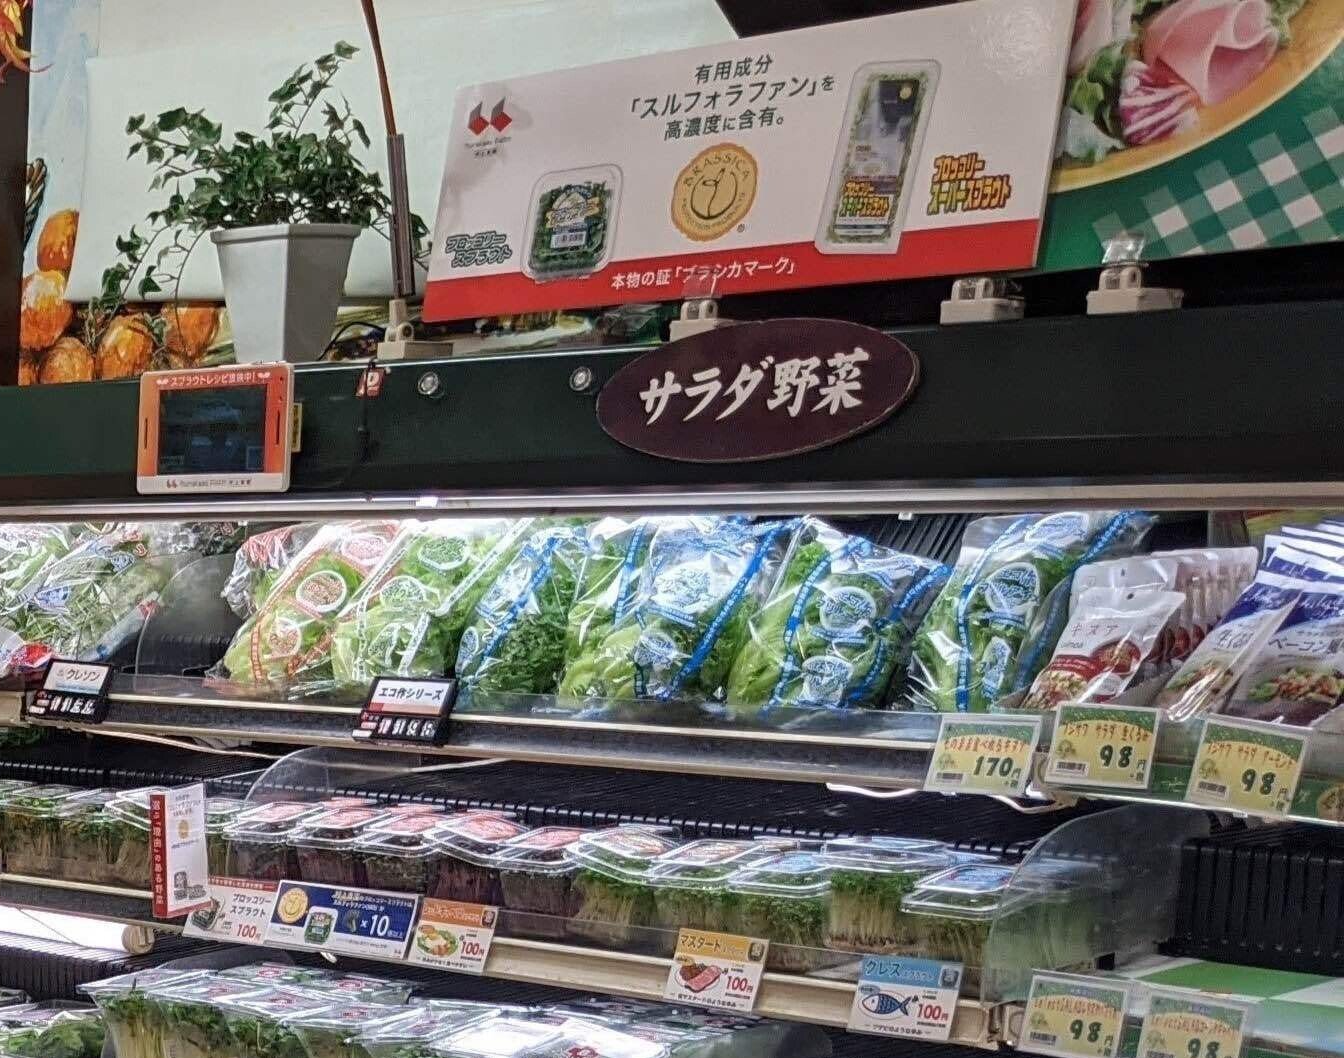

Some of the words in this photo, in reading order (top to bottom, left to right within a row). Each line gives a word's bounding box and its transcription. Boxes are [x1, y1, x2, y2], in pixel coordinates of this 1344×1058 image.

[695, 54, 773, 84] 有用成分
[664, 107, 785, 141] 高濃度に含有。
[638, 346, 874, 425] サラダ野菜
[64, 667, 102, 684] クレソン
[378, 685, 443, 702] エコ作シリーズ
